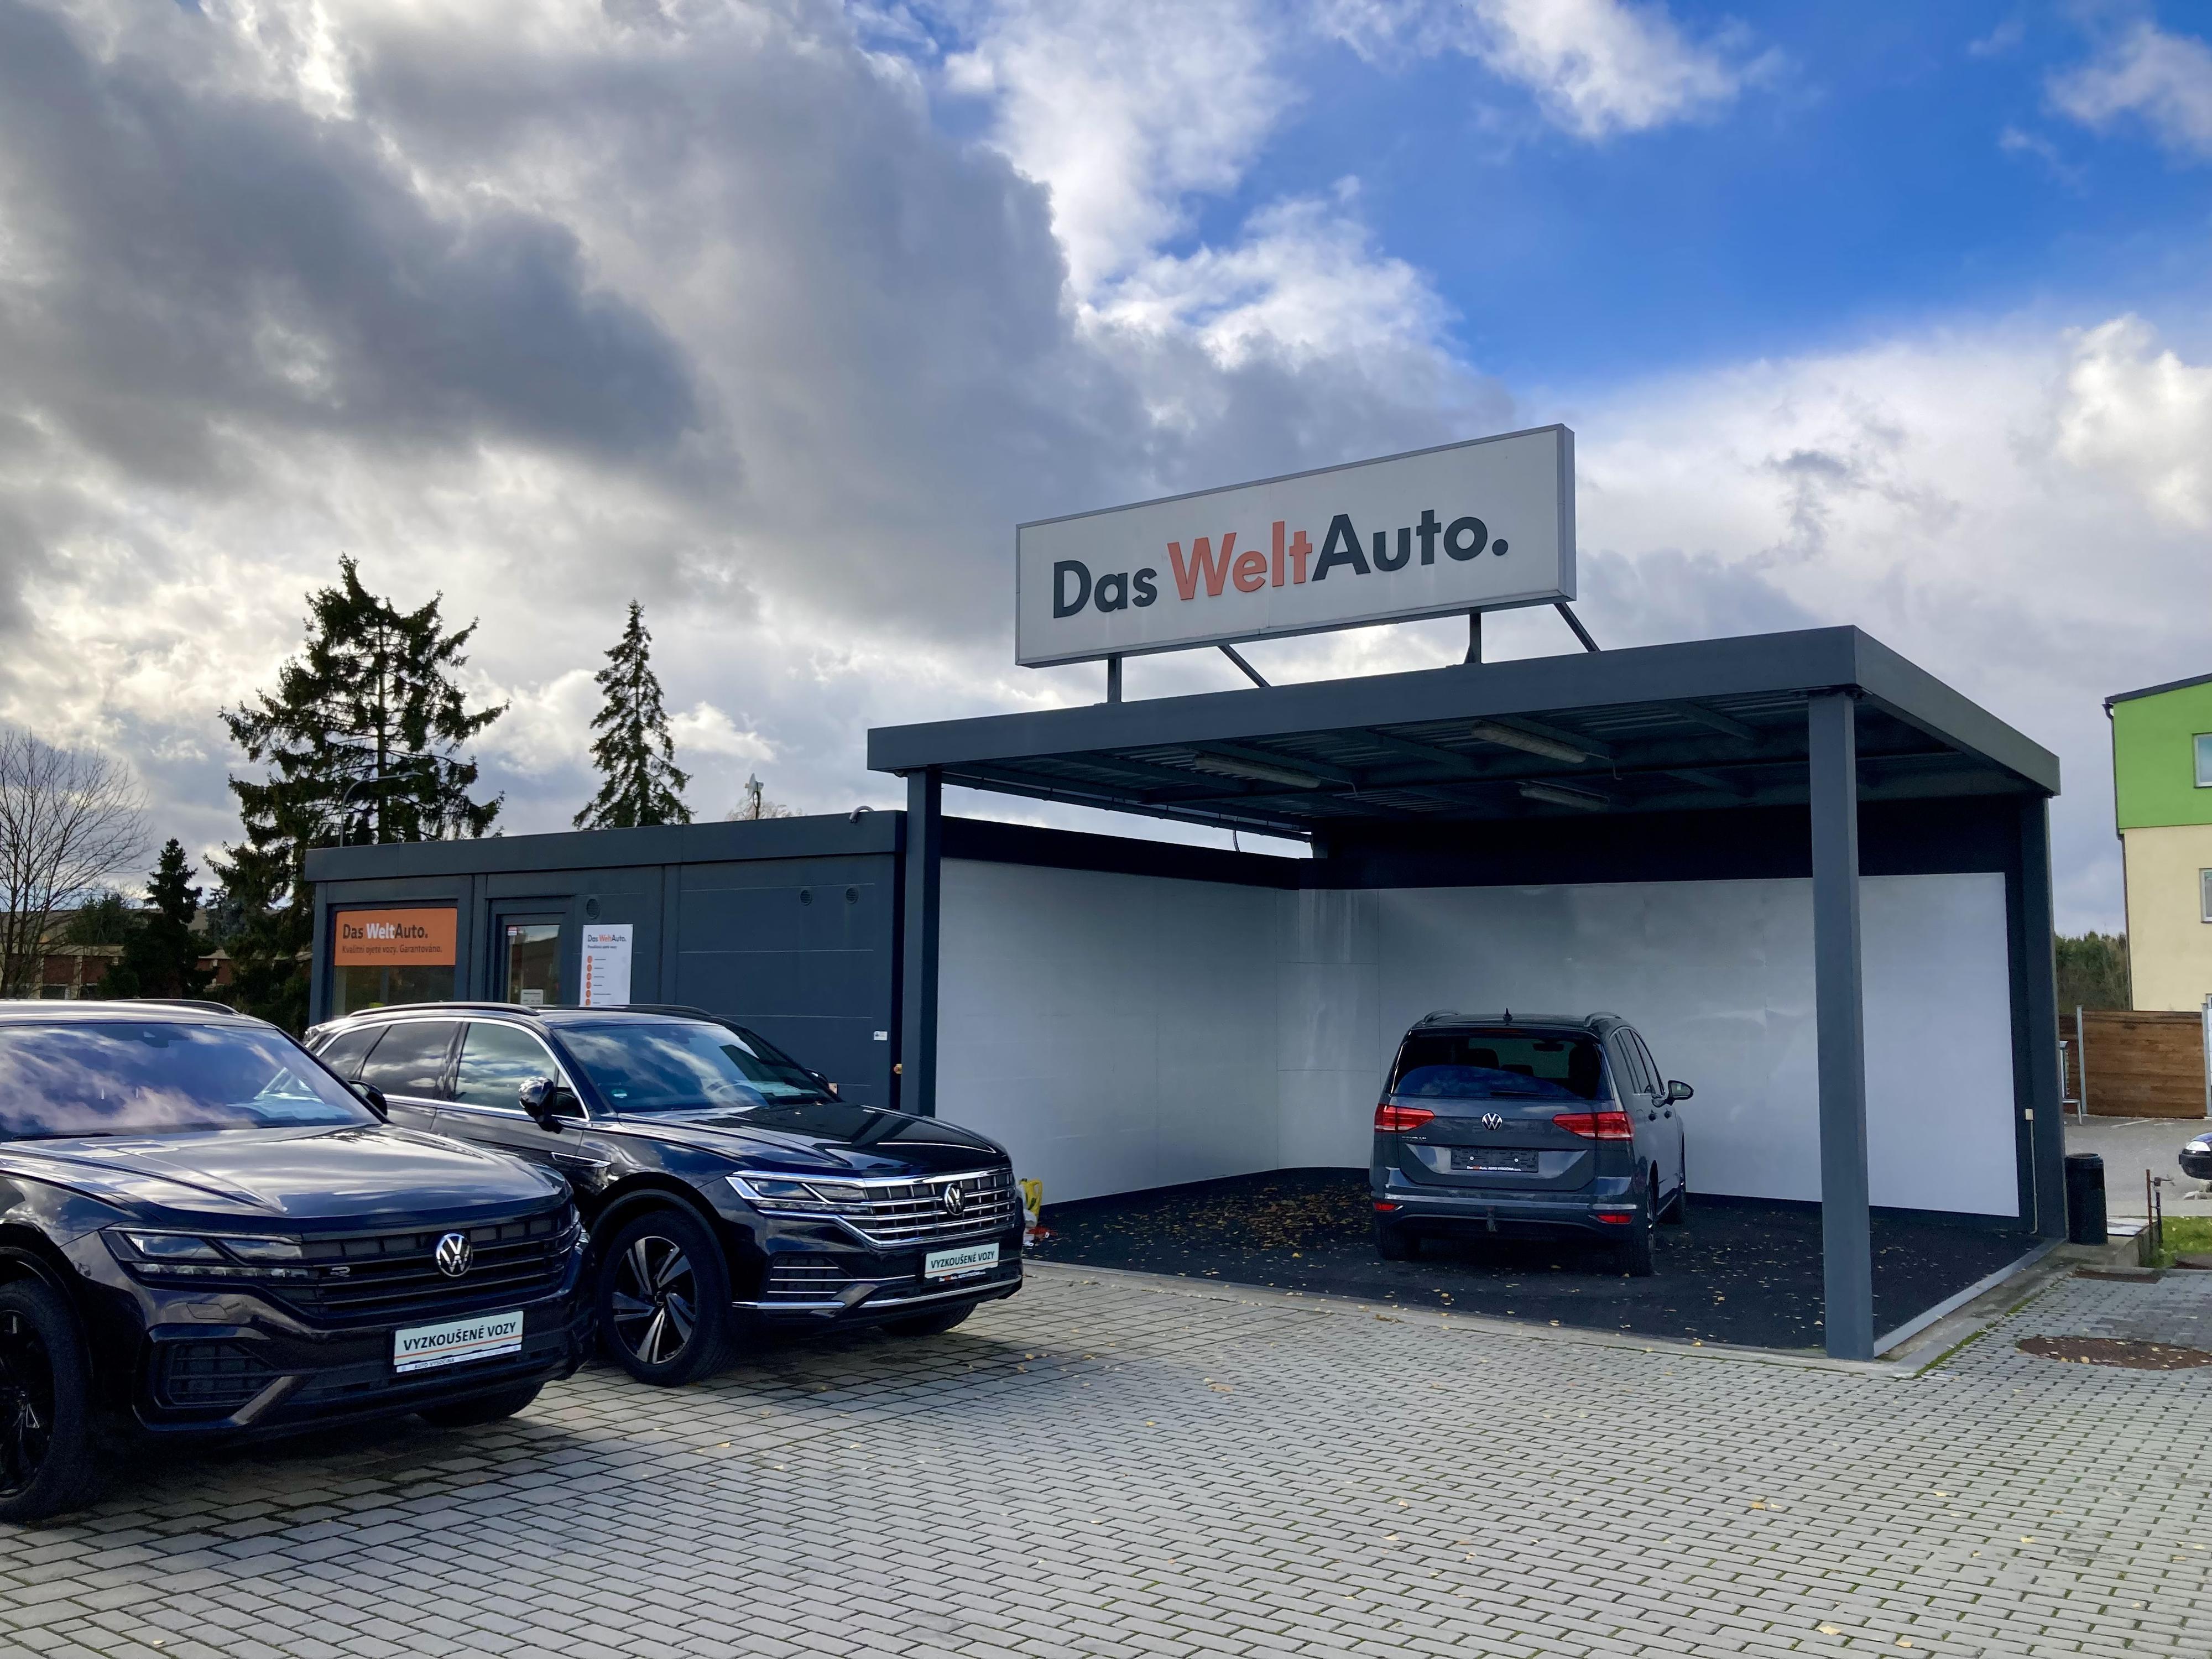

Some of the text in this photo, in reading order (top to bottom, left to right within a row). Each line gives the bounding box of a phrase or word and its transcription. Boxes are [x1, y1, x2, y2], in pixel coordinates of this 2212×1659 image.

[1053, 509, 1509, 618] Das WeltAuto.
[343, 922, 428, 939] Das WeltAuto.
[931, 1250, 995, 1269] VYZKOUŠENÉ VOZY
[404, 1322, 516, 1350] VYZKOUŠENÉ VOZY
